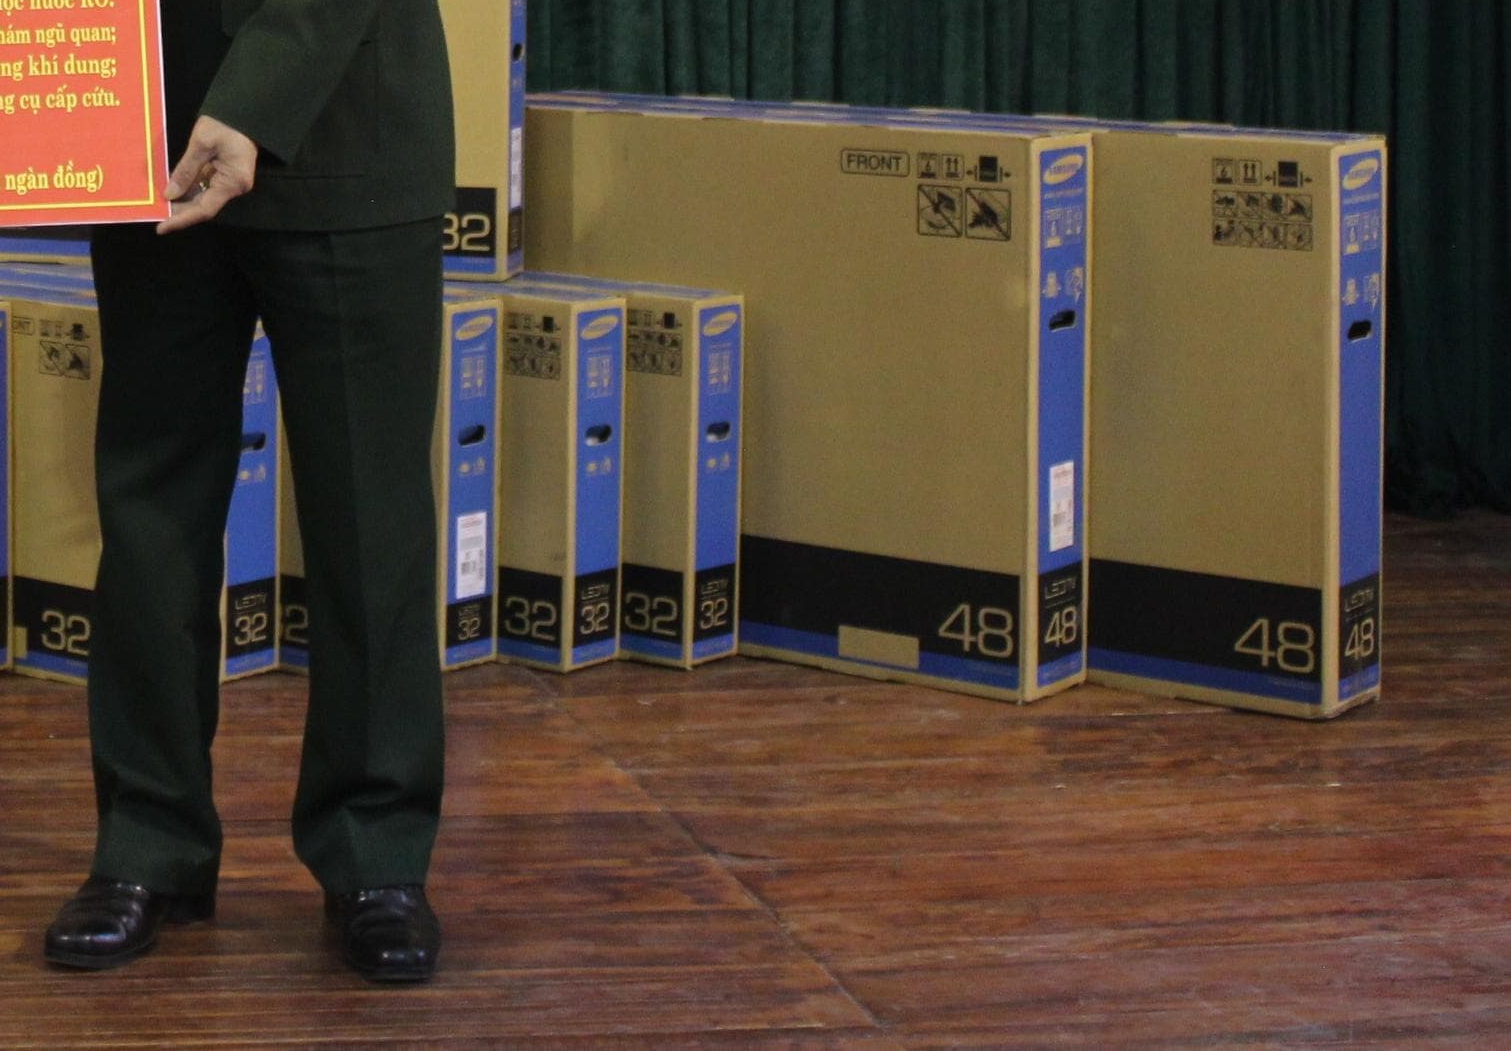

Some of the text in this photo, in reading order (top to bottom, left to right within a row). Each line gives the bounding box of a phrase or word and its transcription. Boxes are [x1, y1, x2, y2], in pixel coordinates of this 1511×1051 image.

[28, 54, 58, 76] khí
[64, 54, 116, 79] dung;
[5, 166, 49, 195] ngàn
[53, 160, 103, 193] đồng)
[847, 153, 903, 173] FRONT
[443, 213, 491, 252] 32
[40, 609, 89, 655] 32
[234, 612, 267, 645] 32
[457, 617, 481, 641] 32
[504, 597, 557, 642] 32
[579, 602, 610, 636] 32
[624, 591, 678, 636] 32
[699, 598, 729, 630] 32
[938, 602, 1014, 659] 48
[1044, 605, 1078, 648] 48
[1233, 616, 1316, 674] 48
[1344, 616, 1375, 660] 48
